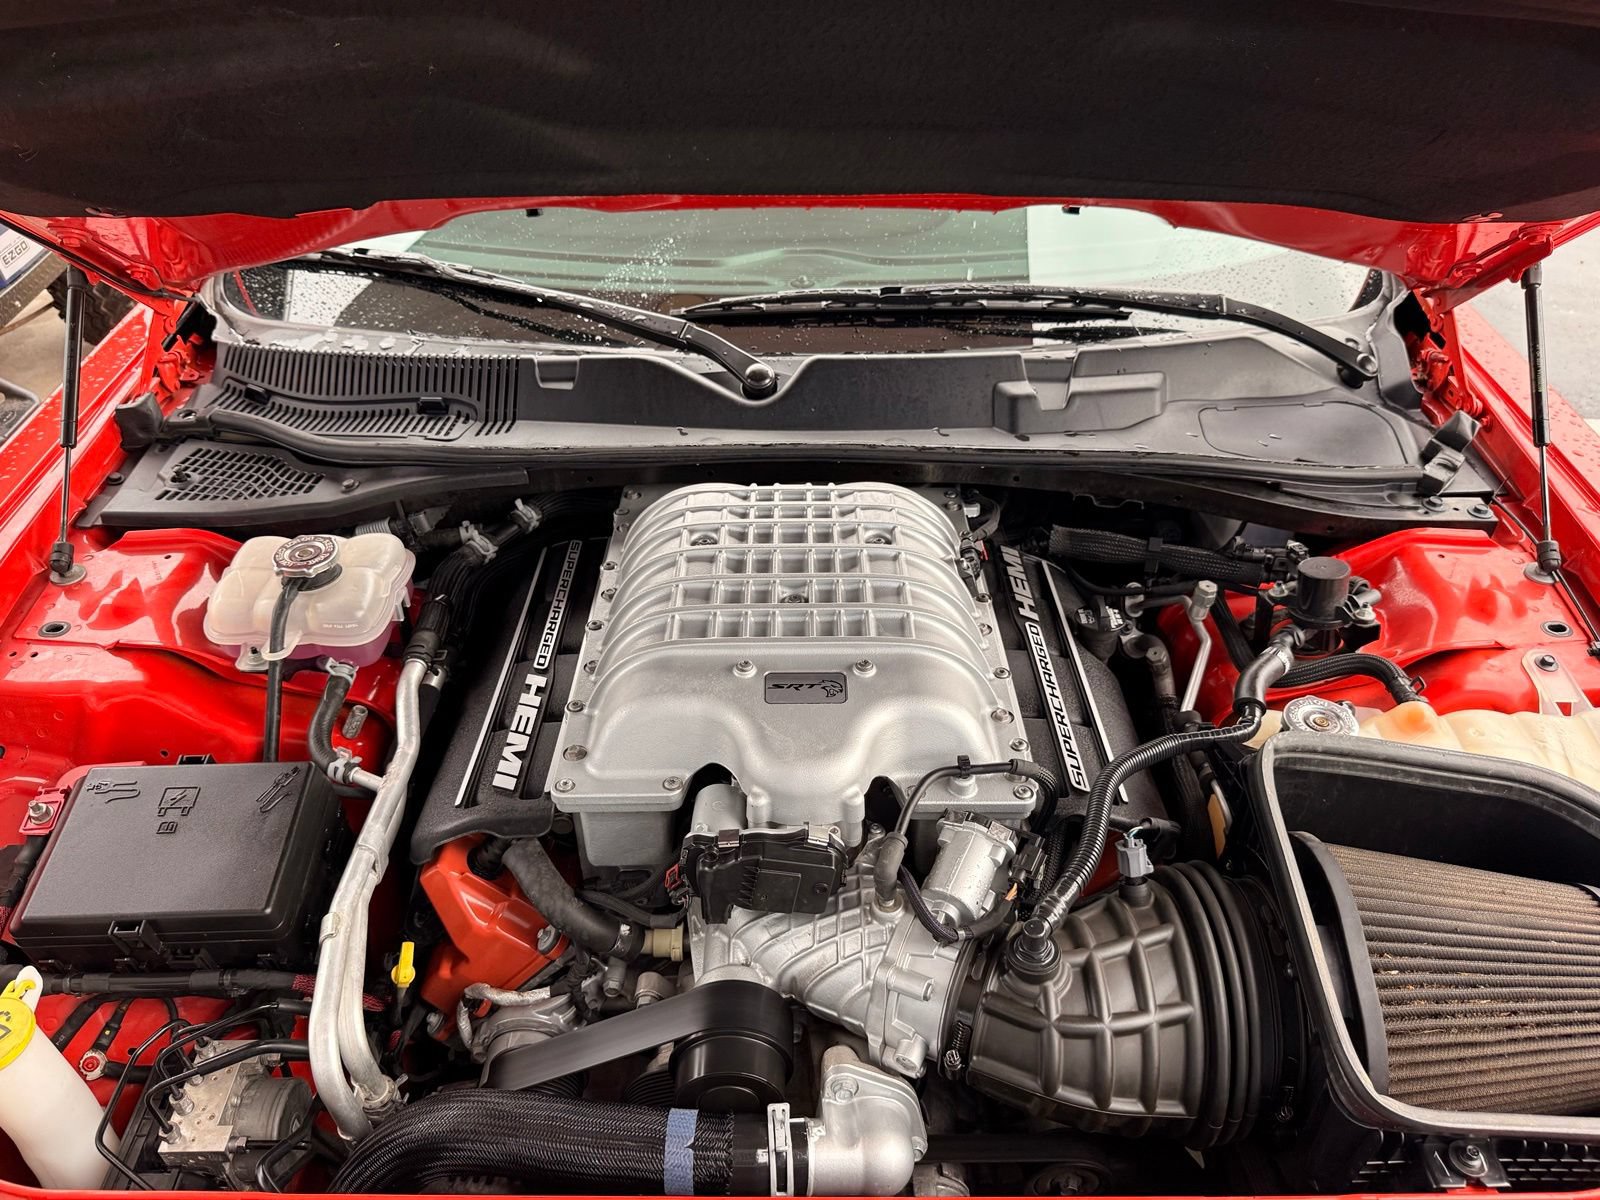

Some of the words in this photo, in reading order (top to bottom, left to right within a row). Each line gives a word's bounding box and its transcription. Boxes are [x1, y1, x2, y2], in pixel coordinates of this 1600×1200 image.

[2, 240, 28, 265] EZGO
[535, 540, 582, 669] SUPERCHARGED
[1000, 545, 1040, 622] HEMI
[492, 673, 548, 791] HEMI
[767, 683, 821, 691] SRT
[1026, 622, 1089, 790] SUPERCHARGED
